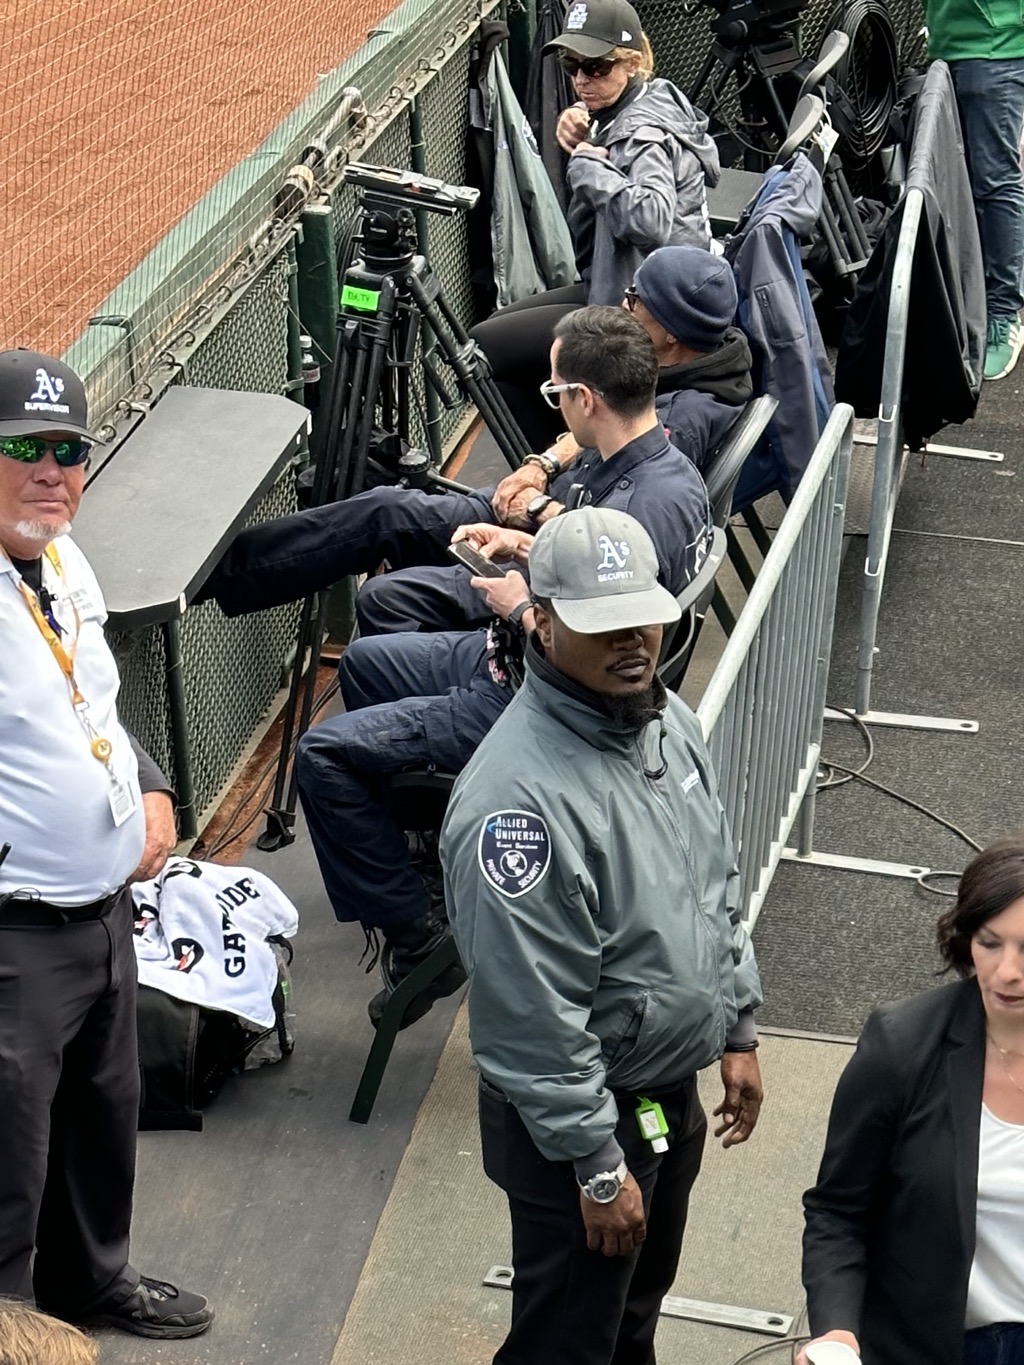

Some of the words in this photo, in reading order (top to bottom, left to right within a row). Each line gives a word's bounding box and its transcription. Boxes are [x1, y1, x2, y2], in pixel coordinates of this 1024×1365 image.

[597, 570, 634, 583] SECURITY
[496, 816, 528, 829] ALLIED
[495, 828, 546, 842] UNIVERSAL
[486, 858, 506, 886] PRIVATE
[517, 859, 542, 889] SECURITY
